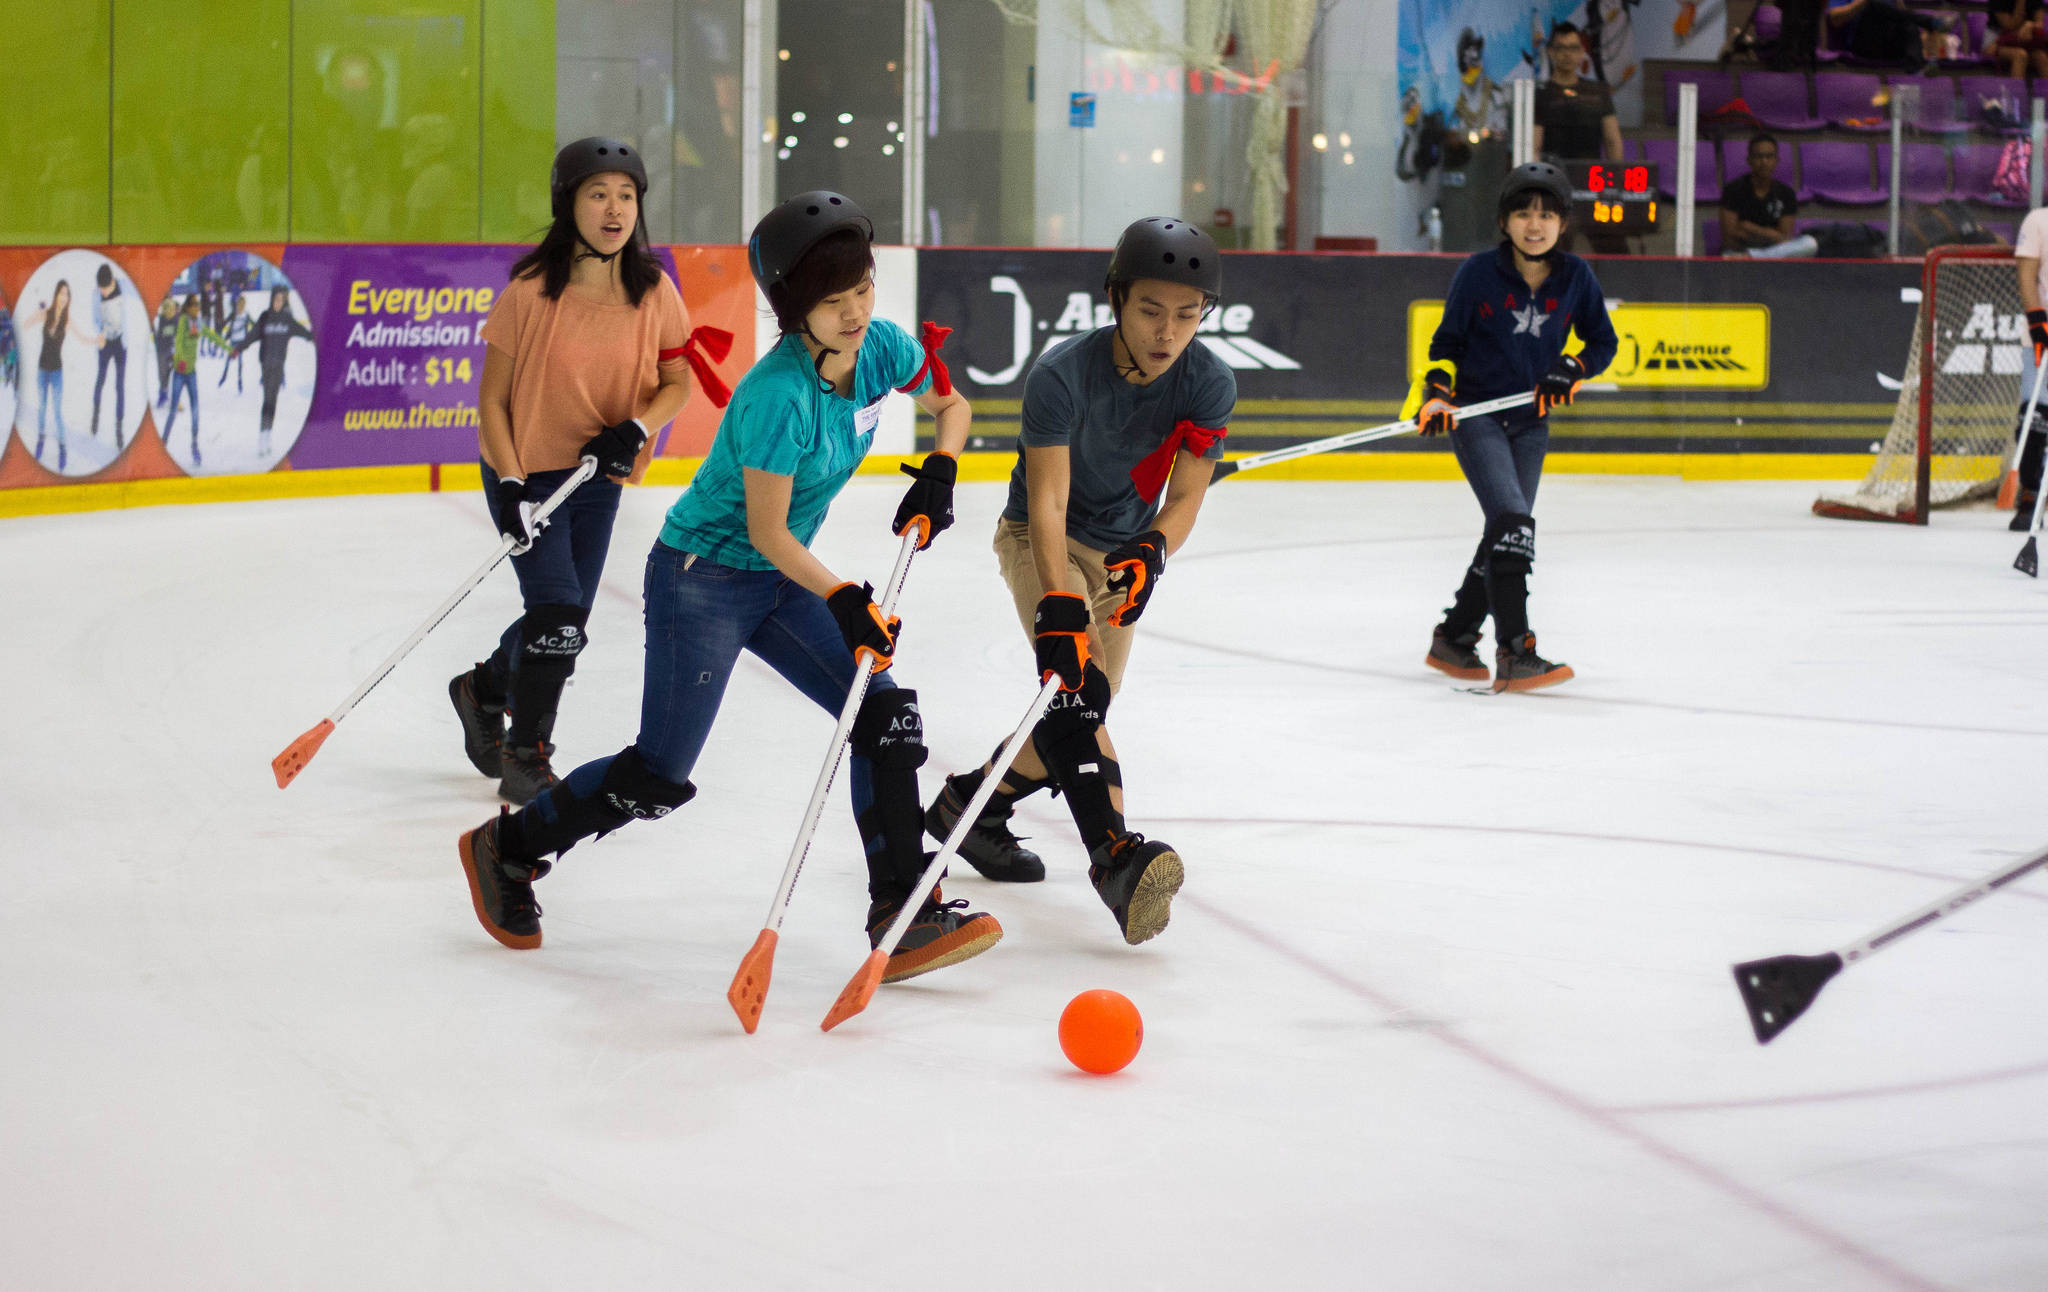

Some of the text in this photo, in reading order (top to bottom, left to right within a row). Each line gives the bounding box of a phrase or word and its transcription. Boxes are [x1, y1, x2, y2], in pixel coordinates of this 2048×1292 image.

[347, 280, 494, 321] Everyone
[345, 320, 471, 348] Admission
[1652, 340, 1732, 355] Avenue
[345, 357, 406, 387] Adult
[425, 356, 472, 387] $14
[344, 401, 480, 431] www.therin
